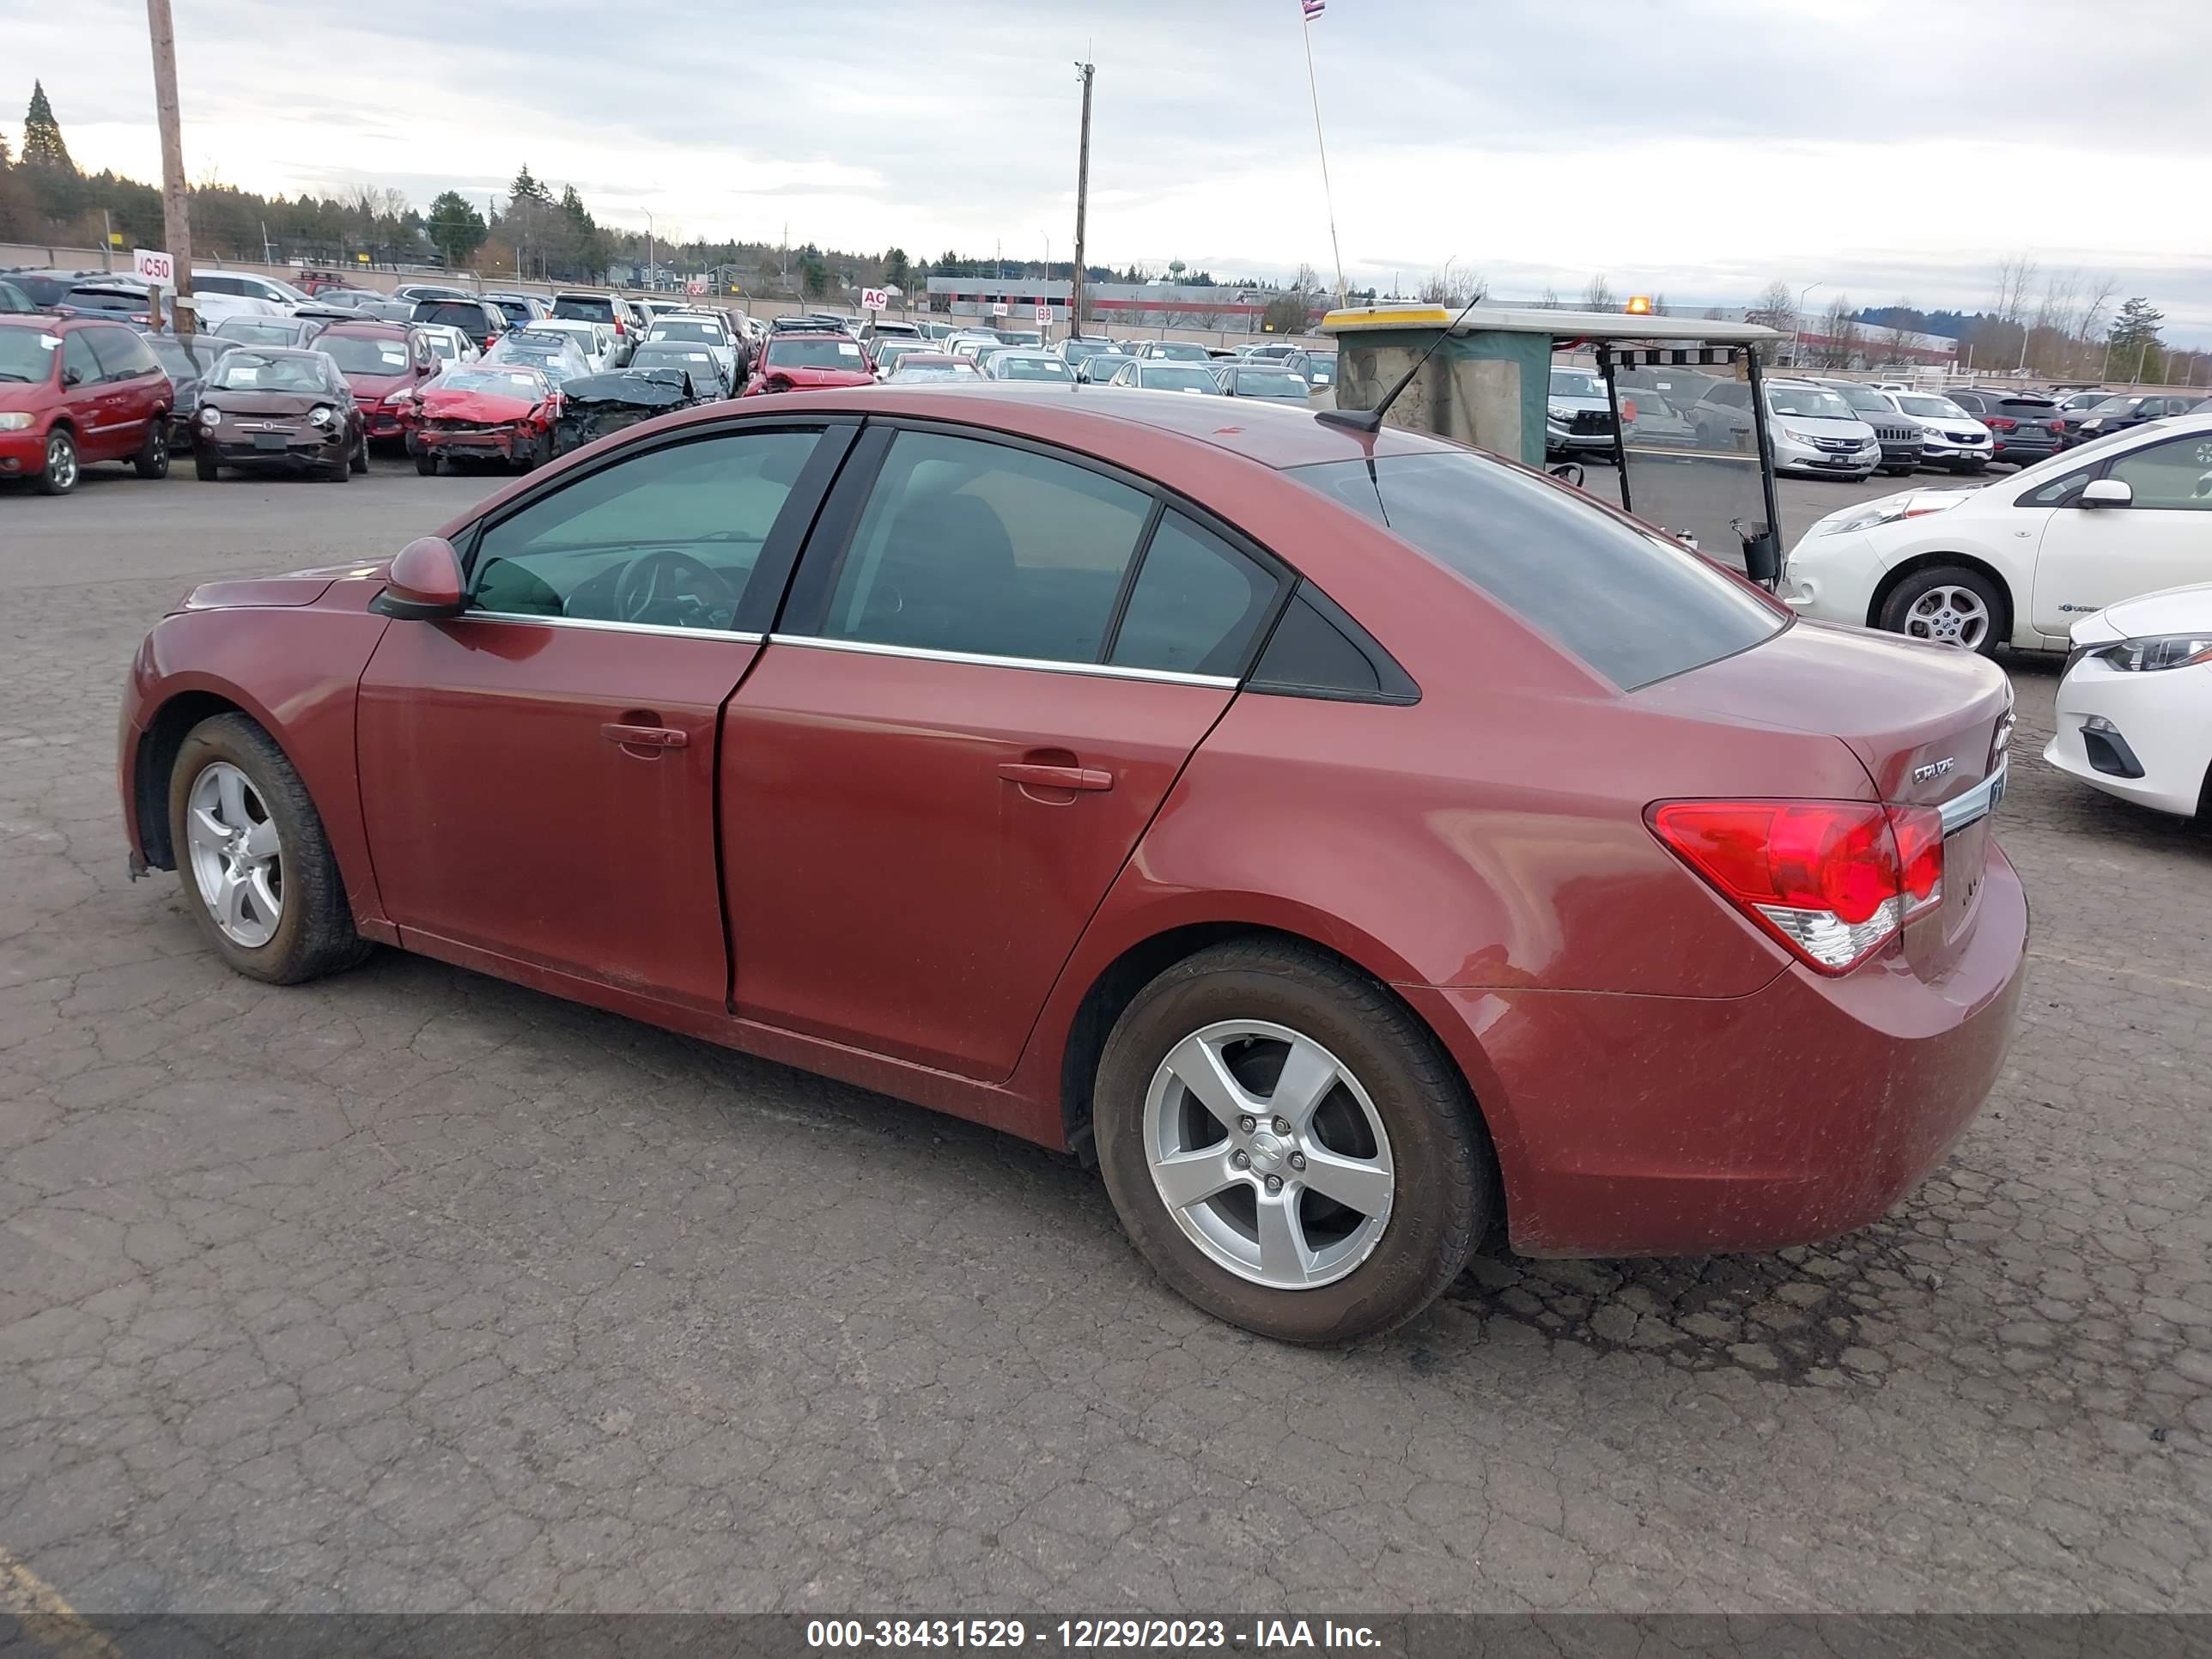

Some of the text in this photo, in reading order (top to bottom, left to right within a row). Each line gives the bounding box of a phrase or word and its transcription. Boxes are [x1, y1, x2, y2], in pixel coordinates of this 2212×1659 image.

[137, 257, 169, 279] AC50
[865, 291, 885, 304] AC
[1038, 308, 1051, 320] BB
[1913, 757, 1954, 783] CRUZE
